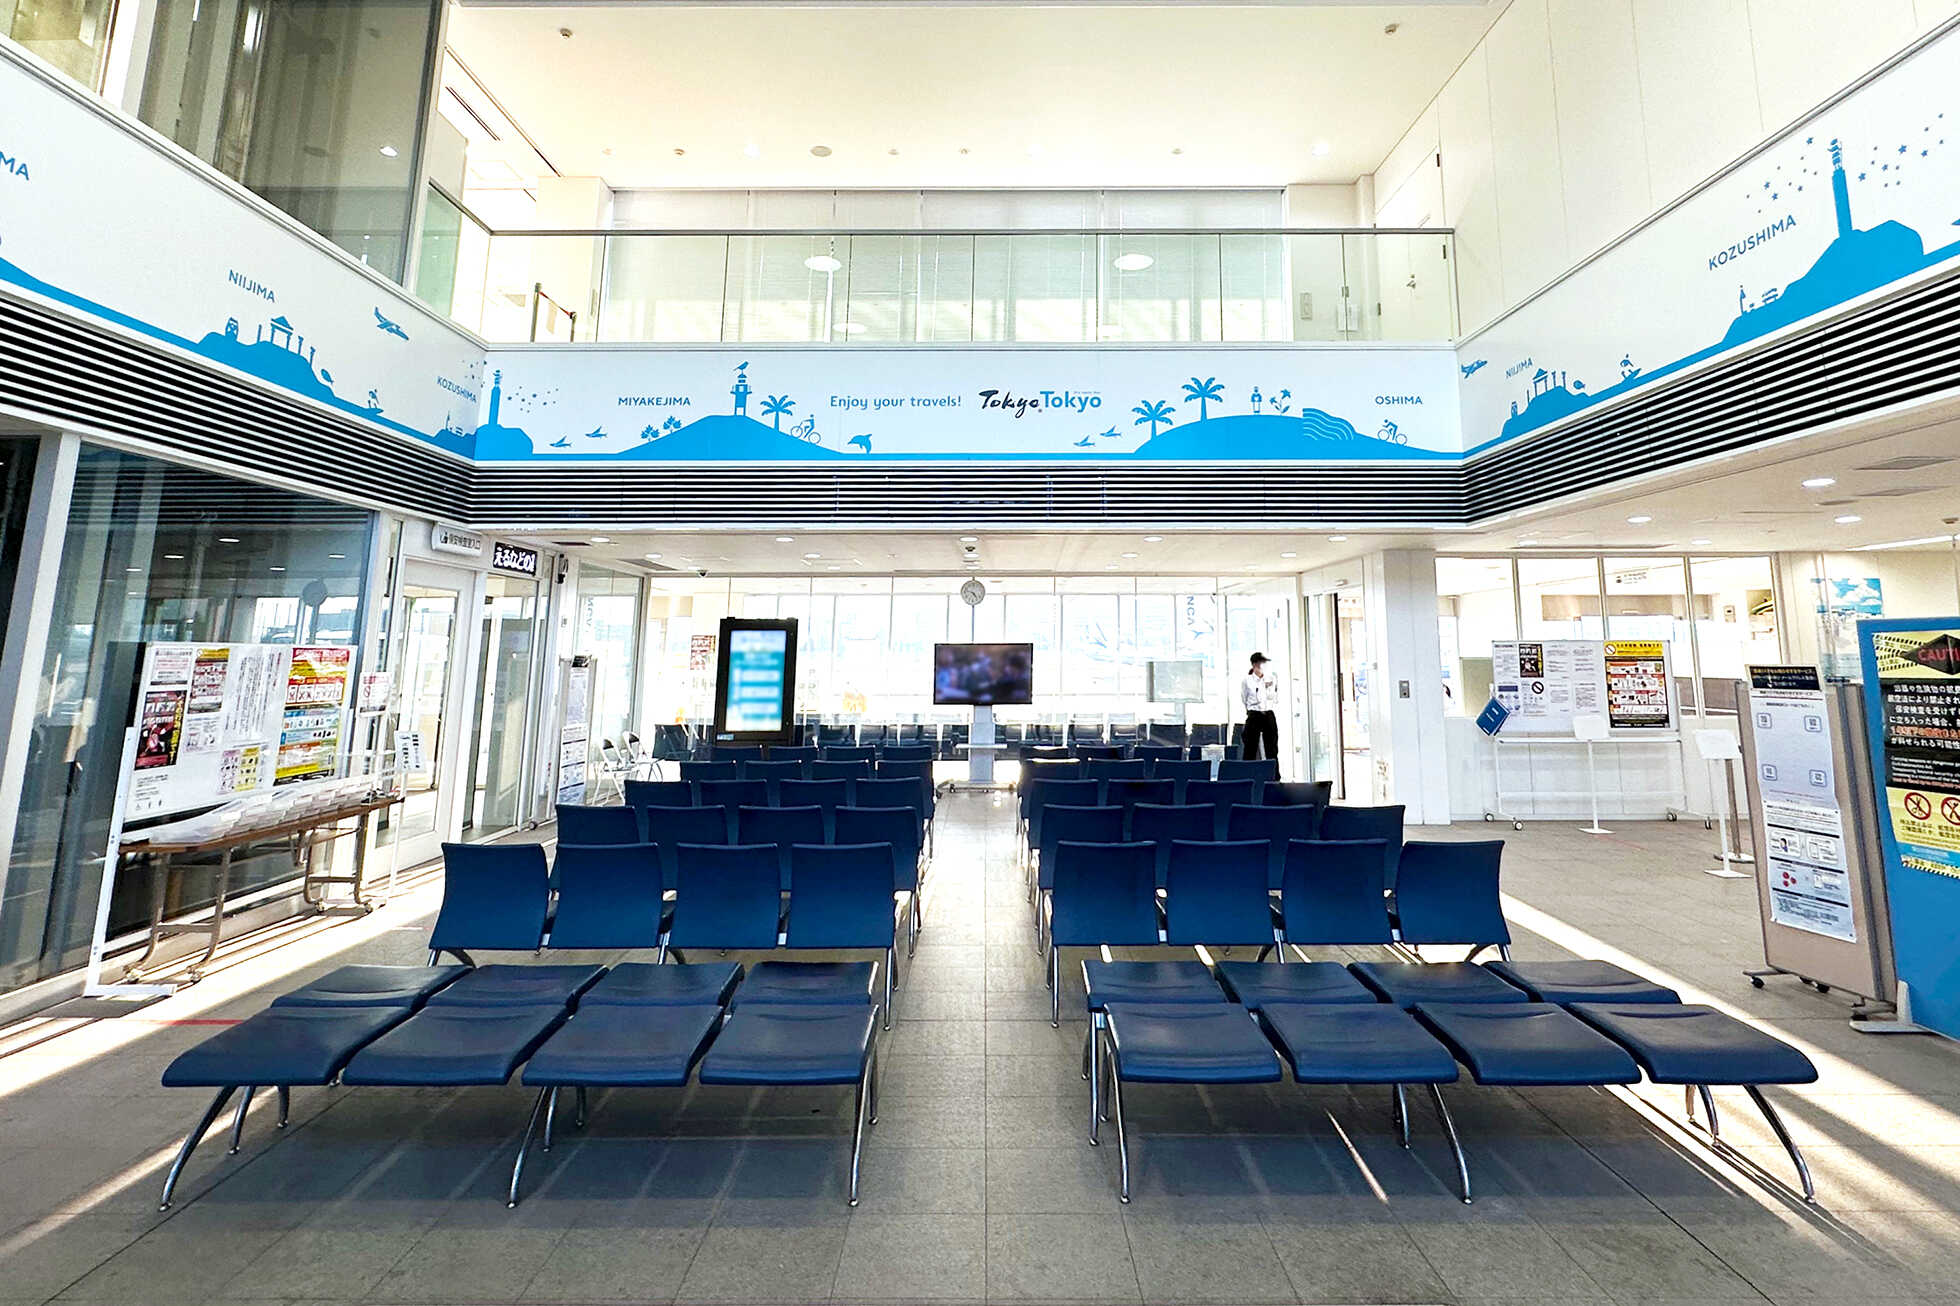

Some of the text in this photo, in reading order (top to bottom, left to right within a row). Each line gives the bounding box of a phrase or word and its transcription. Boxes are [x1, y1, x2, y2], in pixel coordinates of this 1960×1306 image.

[1708, 214, 1797, 271] KOZUSHIMA
[229, 269, 275, 303] NIIJIMA
[618, 397, 691, 406] MIYAKEJIMA
[830, 395, 961, 410] Enjoy your travels!
[1040, 391, 1101, 413] Tokyo
[1375, 395, 1423, 405] OSHIMA
